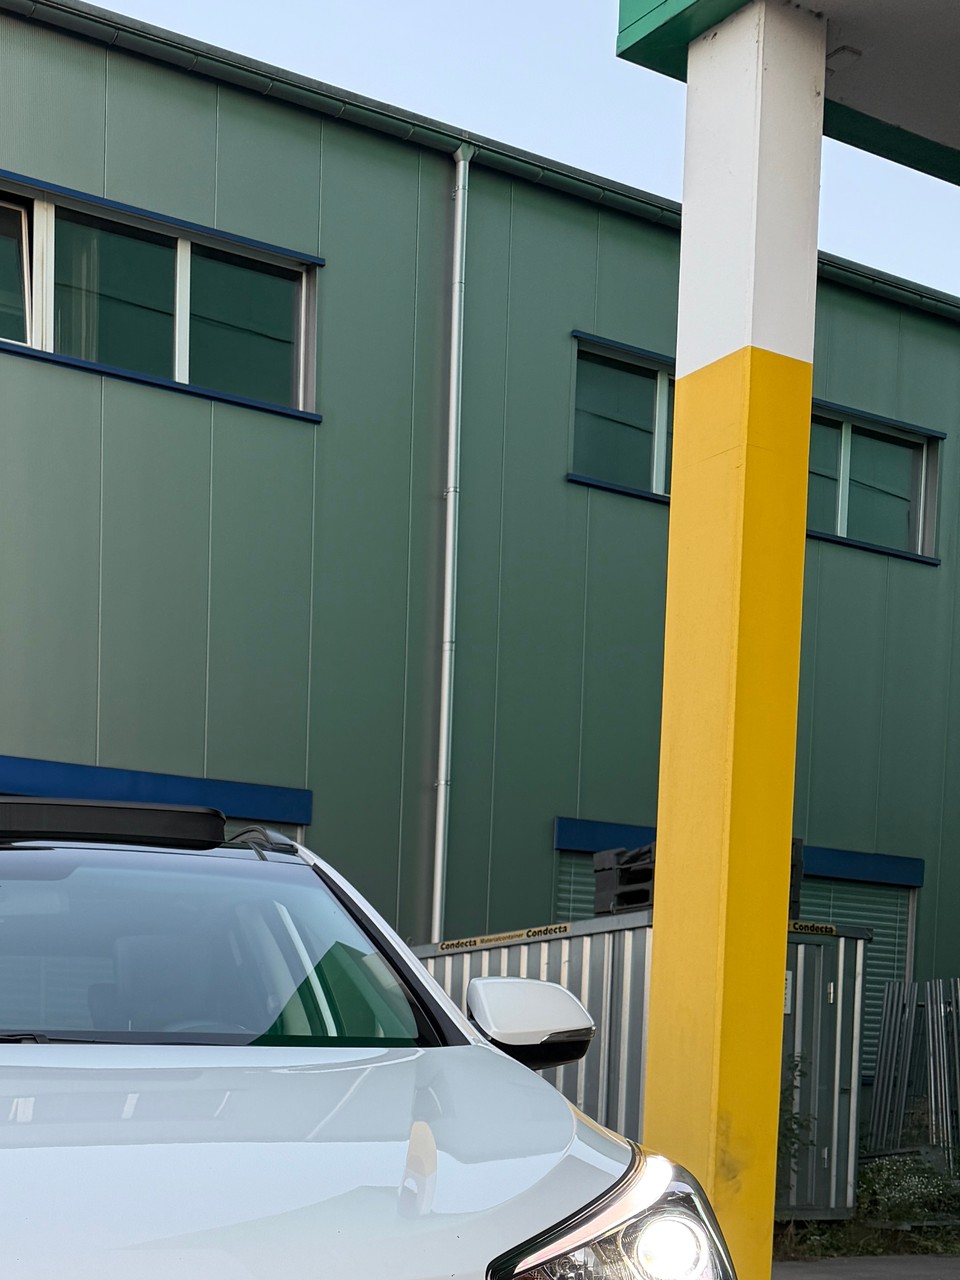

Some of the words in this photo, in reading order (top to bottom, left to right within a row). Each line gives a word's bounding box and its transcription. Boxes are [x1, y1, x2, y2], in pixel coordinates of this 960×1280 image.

[793, 922, 834, 934] Condecta
[440, 939, 477, 951] Condecta
[526, 925, 567, 938] Condecta
